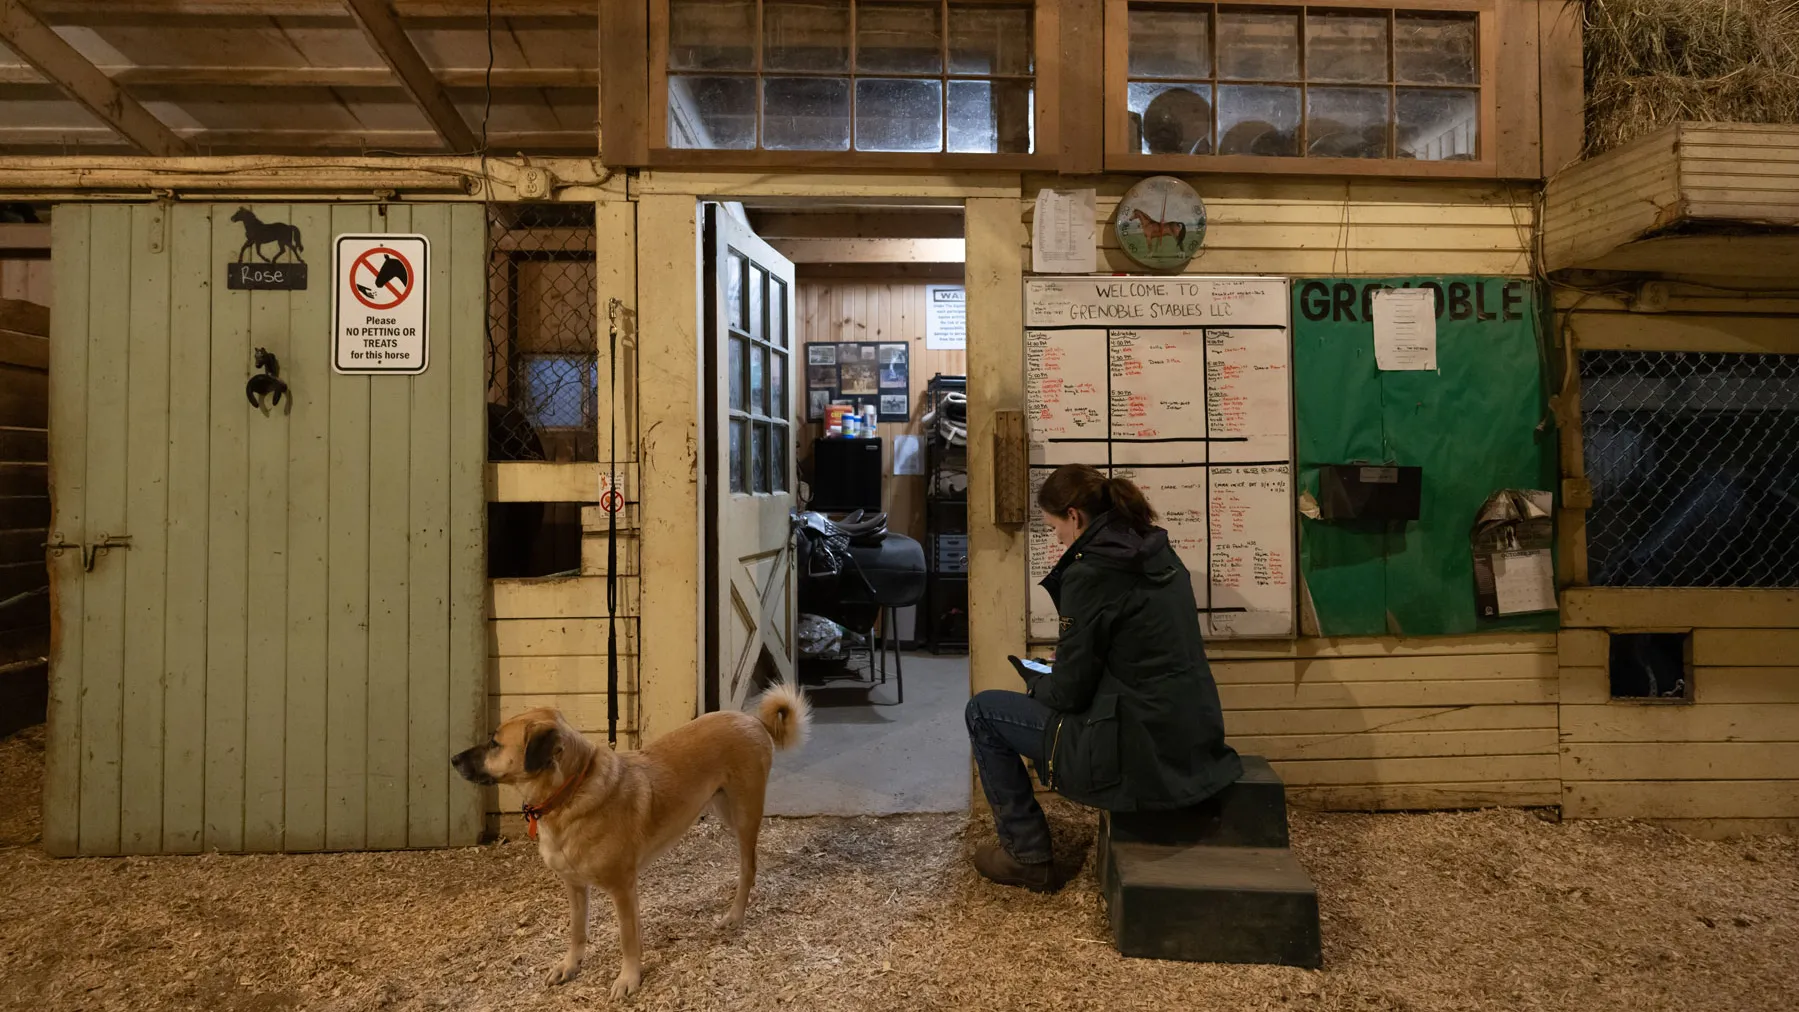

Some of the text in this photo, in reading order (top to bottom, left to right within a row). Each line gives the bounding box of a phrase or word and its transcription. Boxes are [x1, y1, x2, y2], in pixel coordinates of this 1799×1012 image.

[241, 266, 284, 284] Rose
[1176, 283, 1199, 297] TO
[1070, 303, 1145, 320] GRENOBLE
[1150, 302, 1203, 319] STABLES
[1210, 302, 1233, 317] LLC
[366, 316, 397, 325] Please
[346, 327, 416, 336] NO PETTING OR
[363, 339, 398, 348] TREATS
[351, 350, 411, 359] for this horse
[1113, 468, 1134, 477] Sunday
